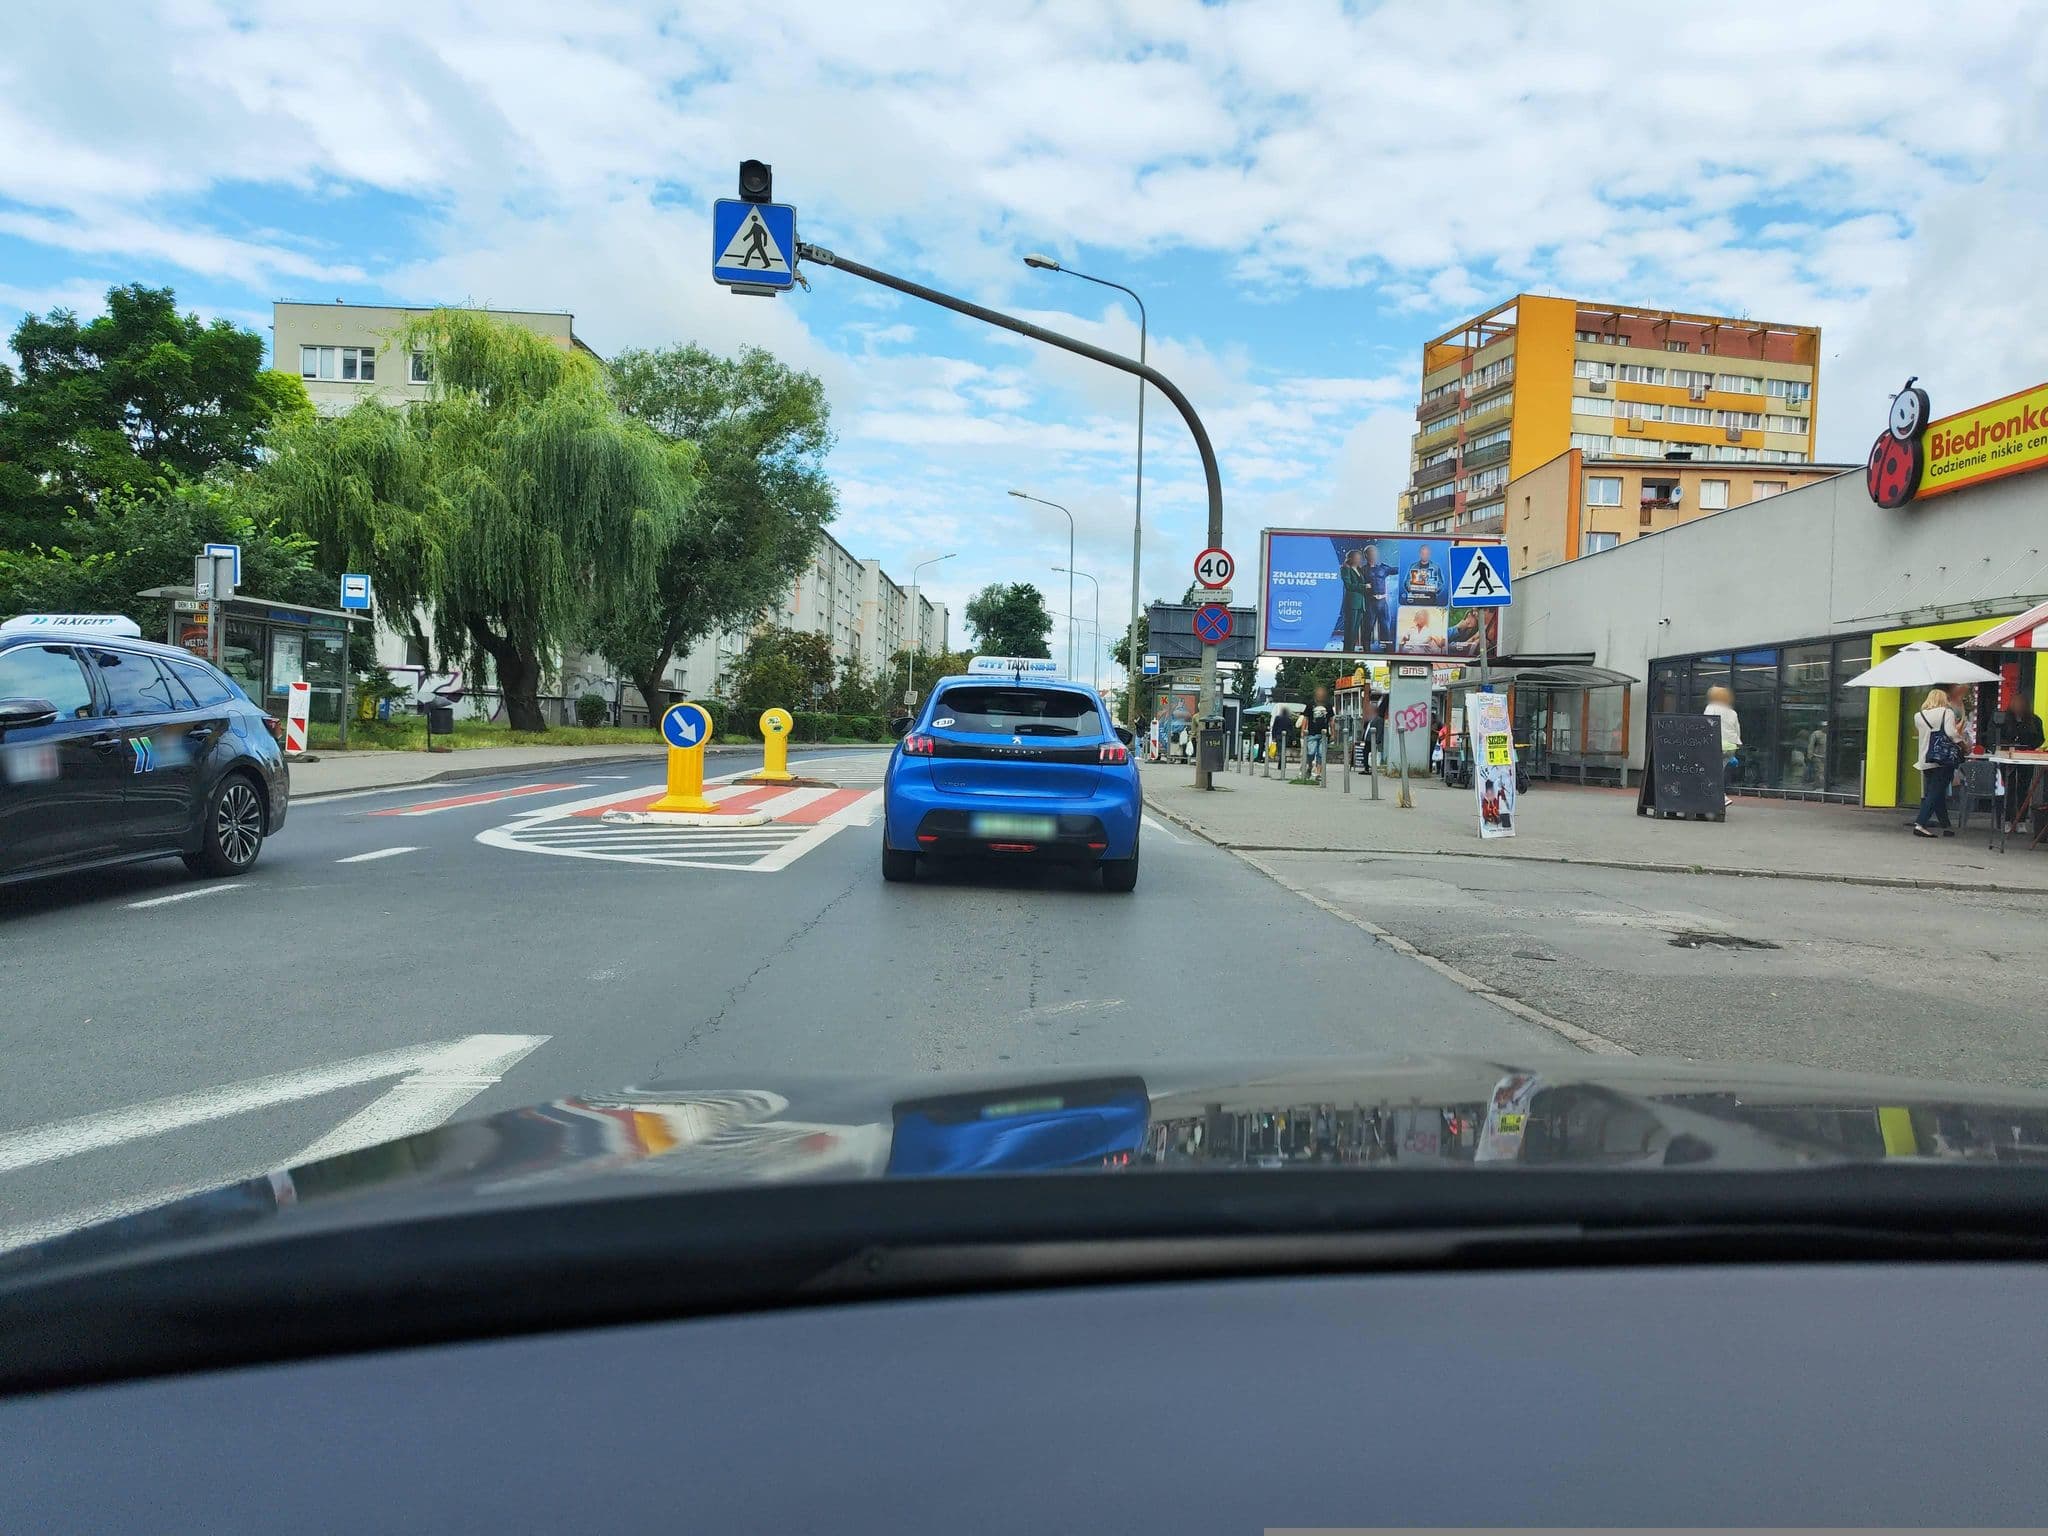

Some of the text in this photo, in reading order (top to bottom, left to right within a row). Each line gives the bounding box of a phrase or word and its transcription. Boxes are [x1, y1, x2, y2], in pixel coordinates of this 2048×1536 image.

[1930, 454, 1987, 477] Codziennie
[1991, 441, 2023, 461] niskie
[1200, 559, 1229, 577] 40
[1272, 571, 1338, 580] ZNAJDZIESZ
[1278, 599, 1303, 608] prime
[1278, 606, 1302, 616] video
[1006, 660, 1030, 671] TAXI
[1402, 666, 1425, 675] ams
